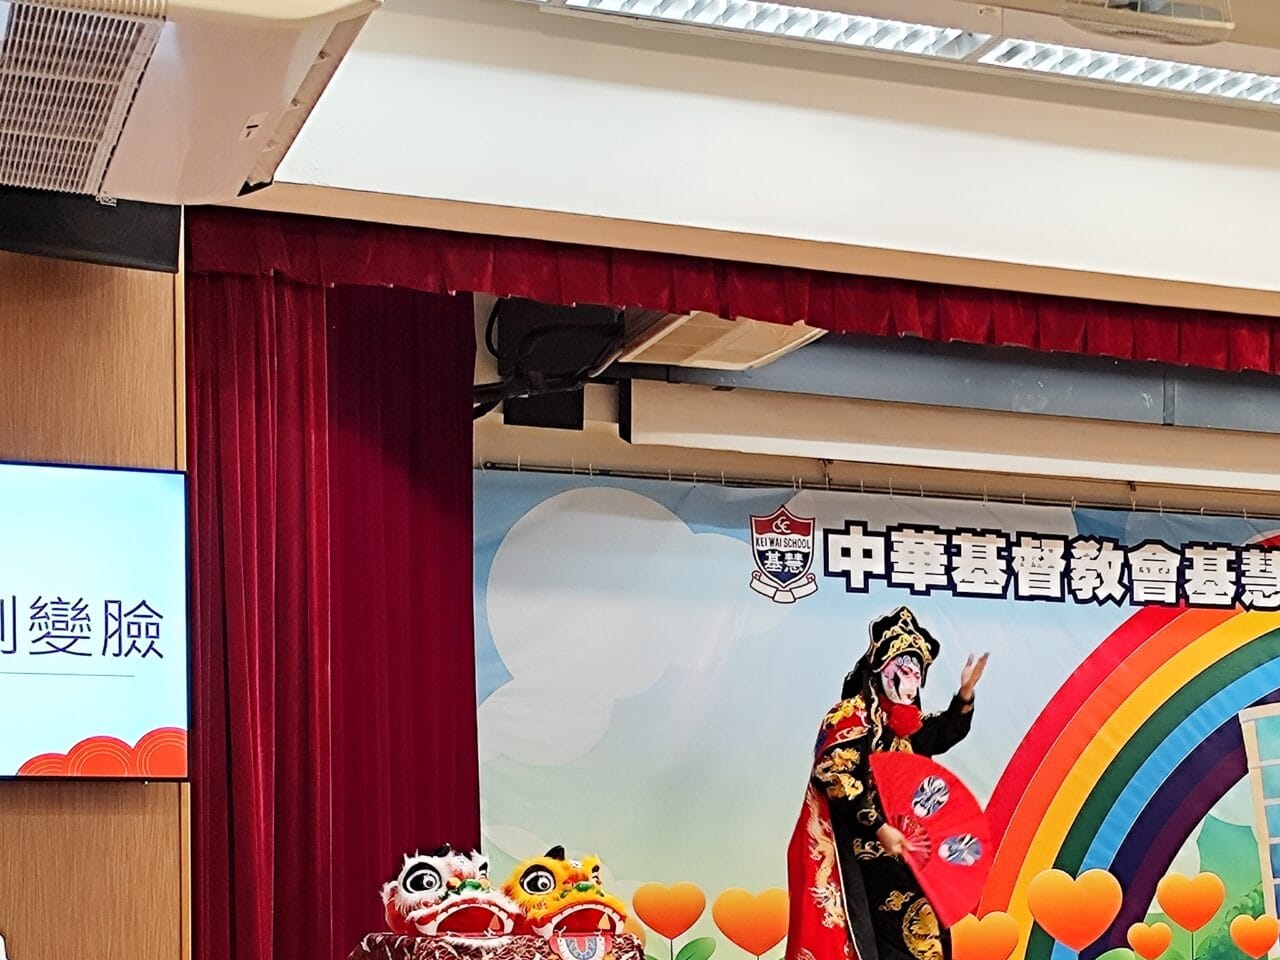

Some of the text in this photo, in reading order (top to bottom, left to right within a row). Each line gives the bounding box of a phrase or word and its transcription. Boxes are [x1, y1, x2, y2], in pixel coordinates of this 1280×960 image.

[756, 537, 811, 549] KEI WAI SCHOOL
[763, 551, 804, 574] 基慧
